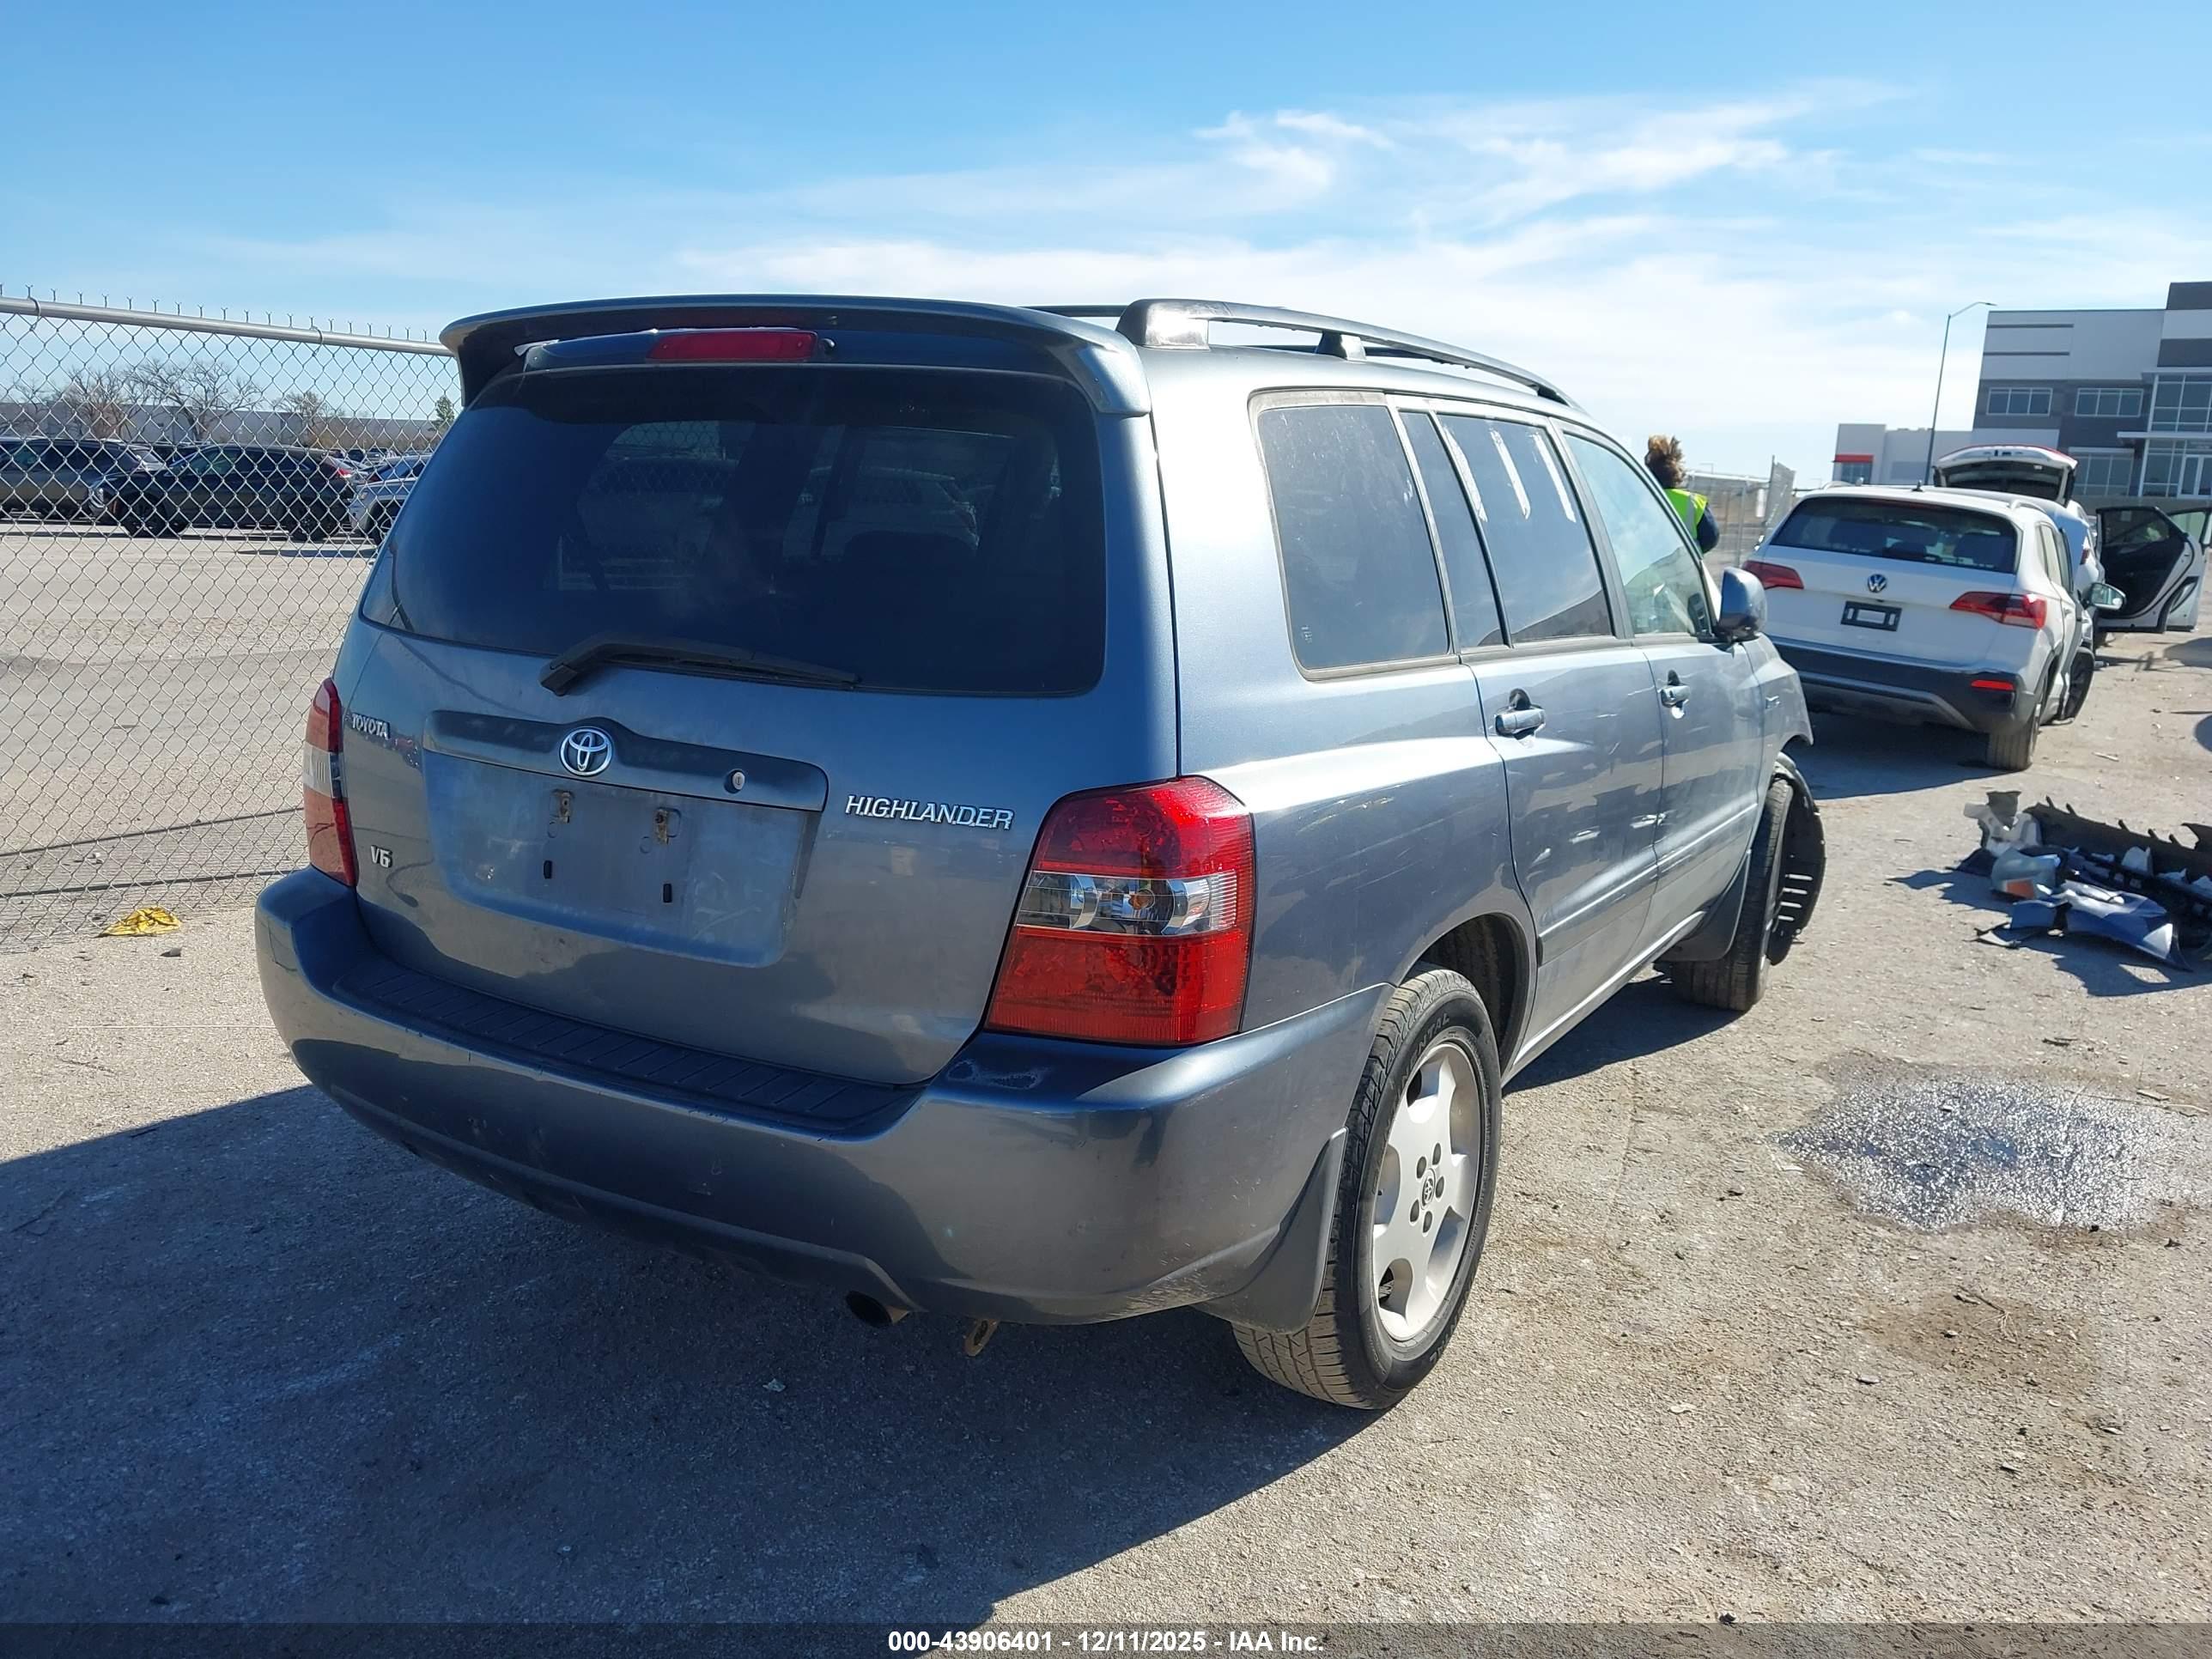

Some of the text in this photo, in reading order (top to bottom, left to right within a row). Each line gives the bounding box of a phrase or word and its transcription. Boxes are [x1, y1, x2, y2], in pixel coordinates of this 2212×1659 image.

[352, 713, 390, 740] TOYOTA
[845, 794, 1015, 830] HIGHLANDER
[371, 845, 392, 868] V6
